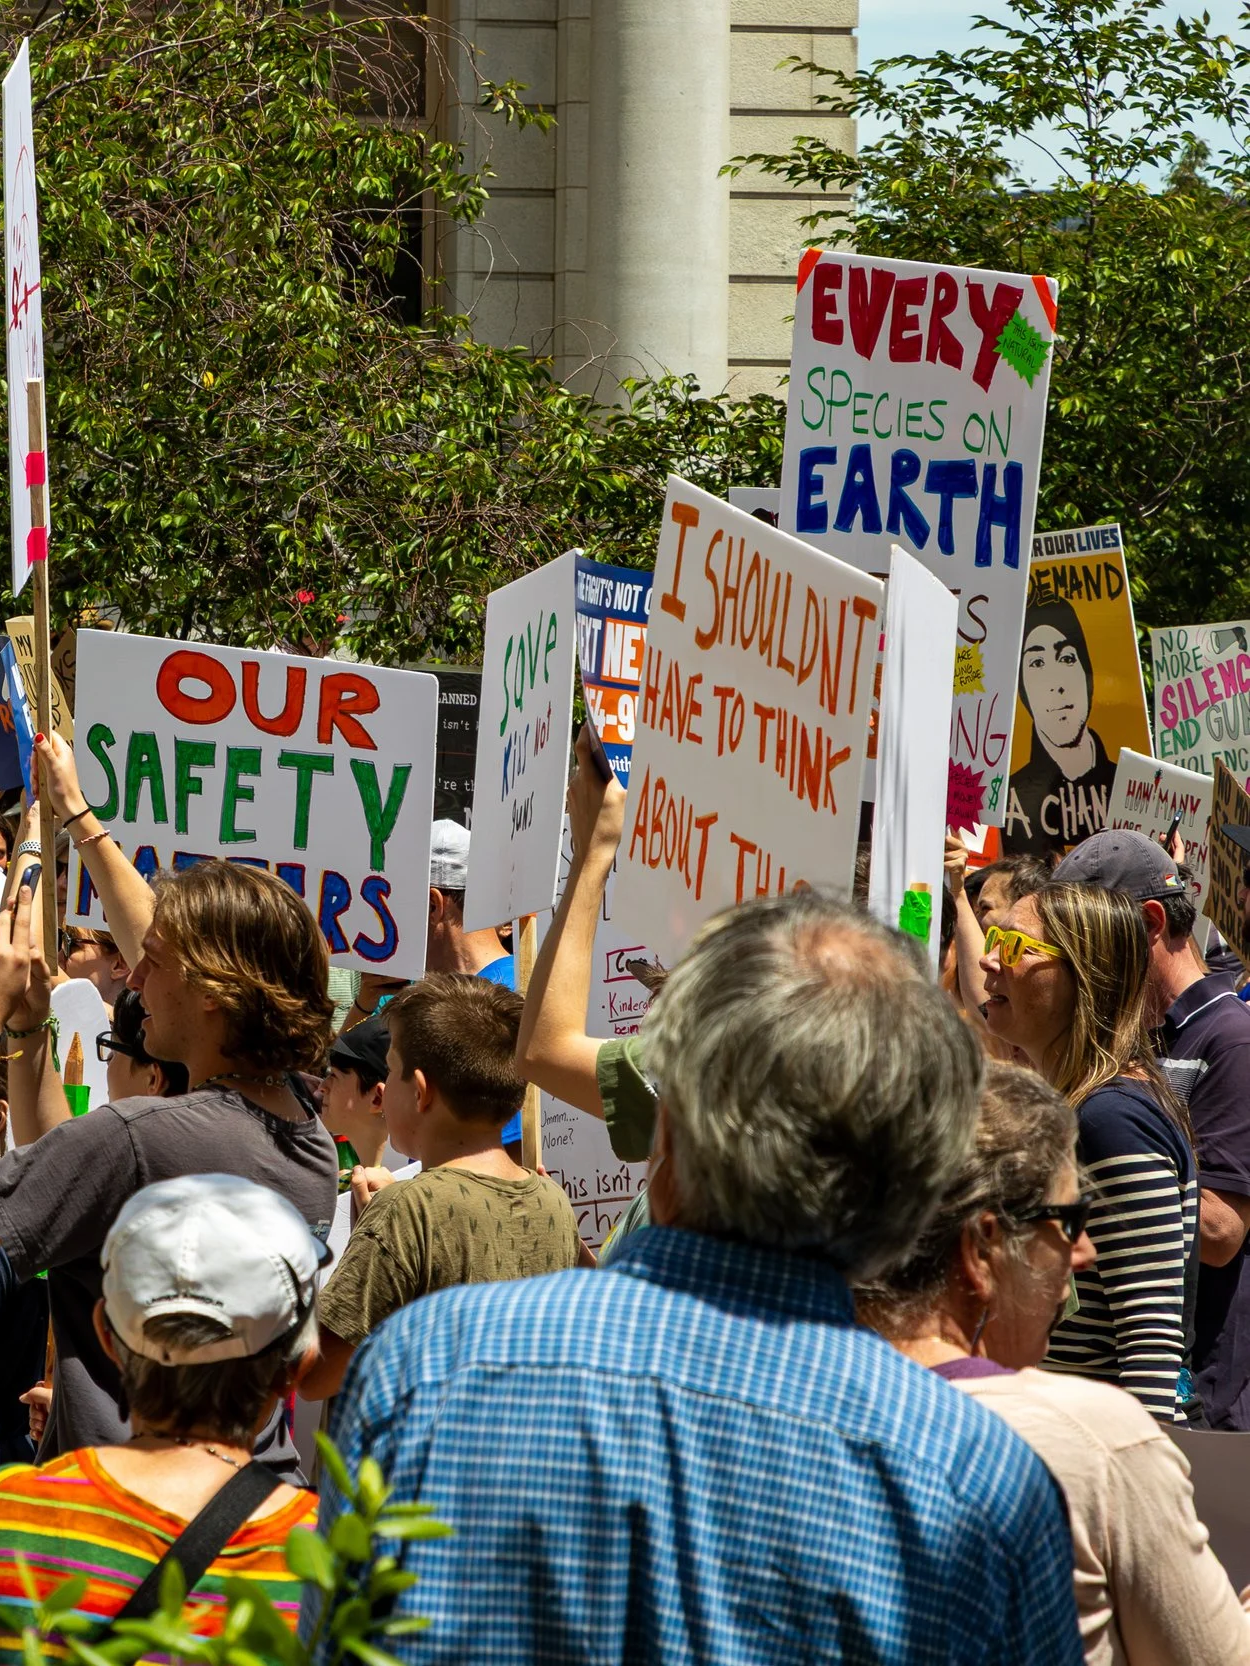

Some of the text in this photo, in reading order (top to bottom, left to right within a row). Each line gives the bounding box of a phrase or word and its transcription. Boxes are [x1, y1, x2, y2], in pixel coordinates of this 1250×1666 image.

[812, 263, 1024, 394] EVERY
[1002, 338, 1036, 369] NATURAL
[801, 366, 1012, 458] SPECIES ON
[796, 443, 1023, 569] EARTH
[660, 501, 700, 623] I
[1044, 534, 1076, 555] OUR
[1076, 528, 1121, 552] LIVES
[613, 582, 644, 613] NOT
[15, 635, 33, 657] MY
[1160, 629, 1188, 655] NO
[1155, 645, 1204, 682] MORE
[155, 649, 381, 751] OUR
[442, 719, 470, 731] isn't
[642, 645, 852, 816] HAVE TO THINK
[1160, 718, 1201, 759] END
[85, 722, 413, 873] SAFETY
[1125, 779, 1201, 820] HOW MANY
[1217, 767, 1231, 807] NO
[629, 763, 718, 901] ABOUT
[1005, 787, 1033, 840] A
[542, 1127, 574, 1151] None?
[596, 1164, 632, 1195] isn't
